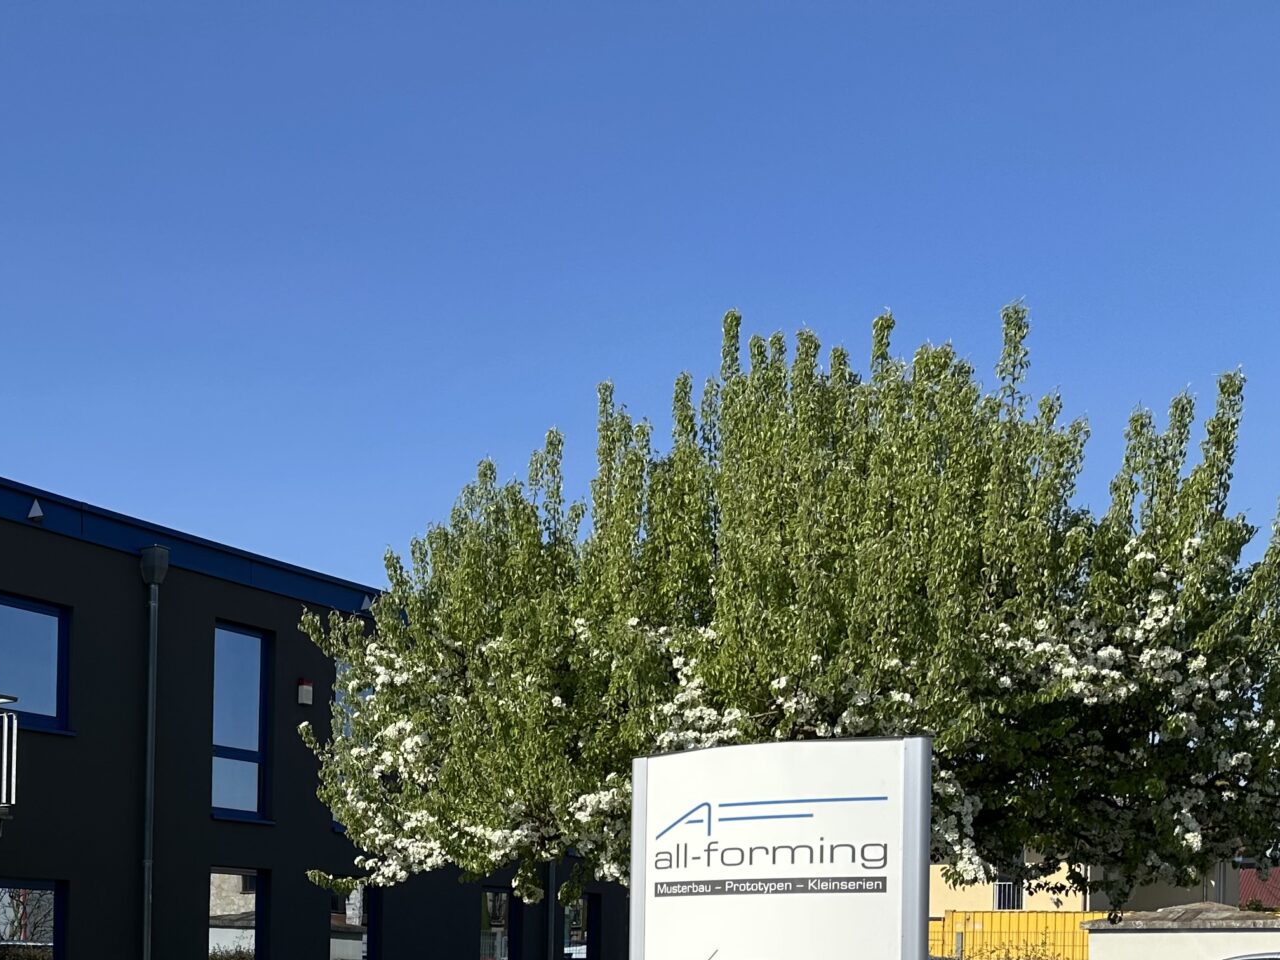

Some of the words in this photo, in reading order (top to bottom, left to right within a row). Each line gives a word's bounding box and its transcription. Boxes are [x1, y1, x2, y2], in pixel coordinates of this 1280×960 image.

[654, 837, 888, 870] all-forming
[656, 882, 712, 894] Musterbau
[725, 880, 792, 893] Prototypen
[807, 878, 883, 891] Kleinserien
